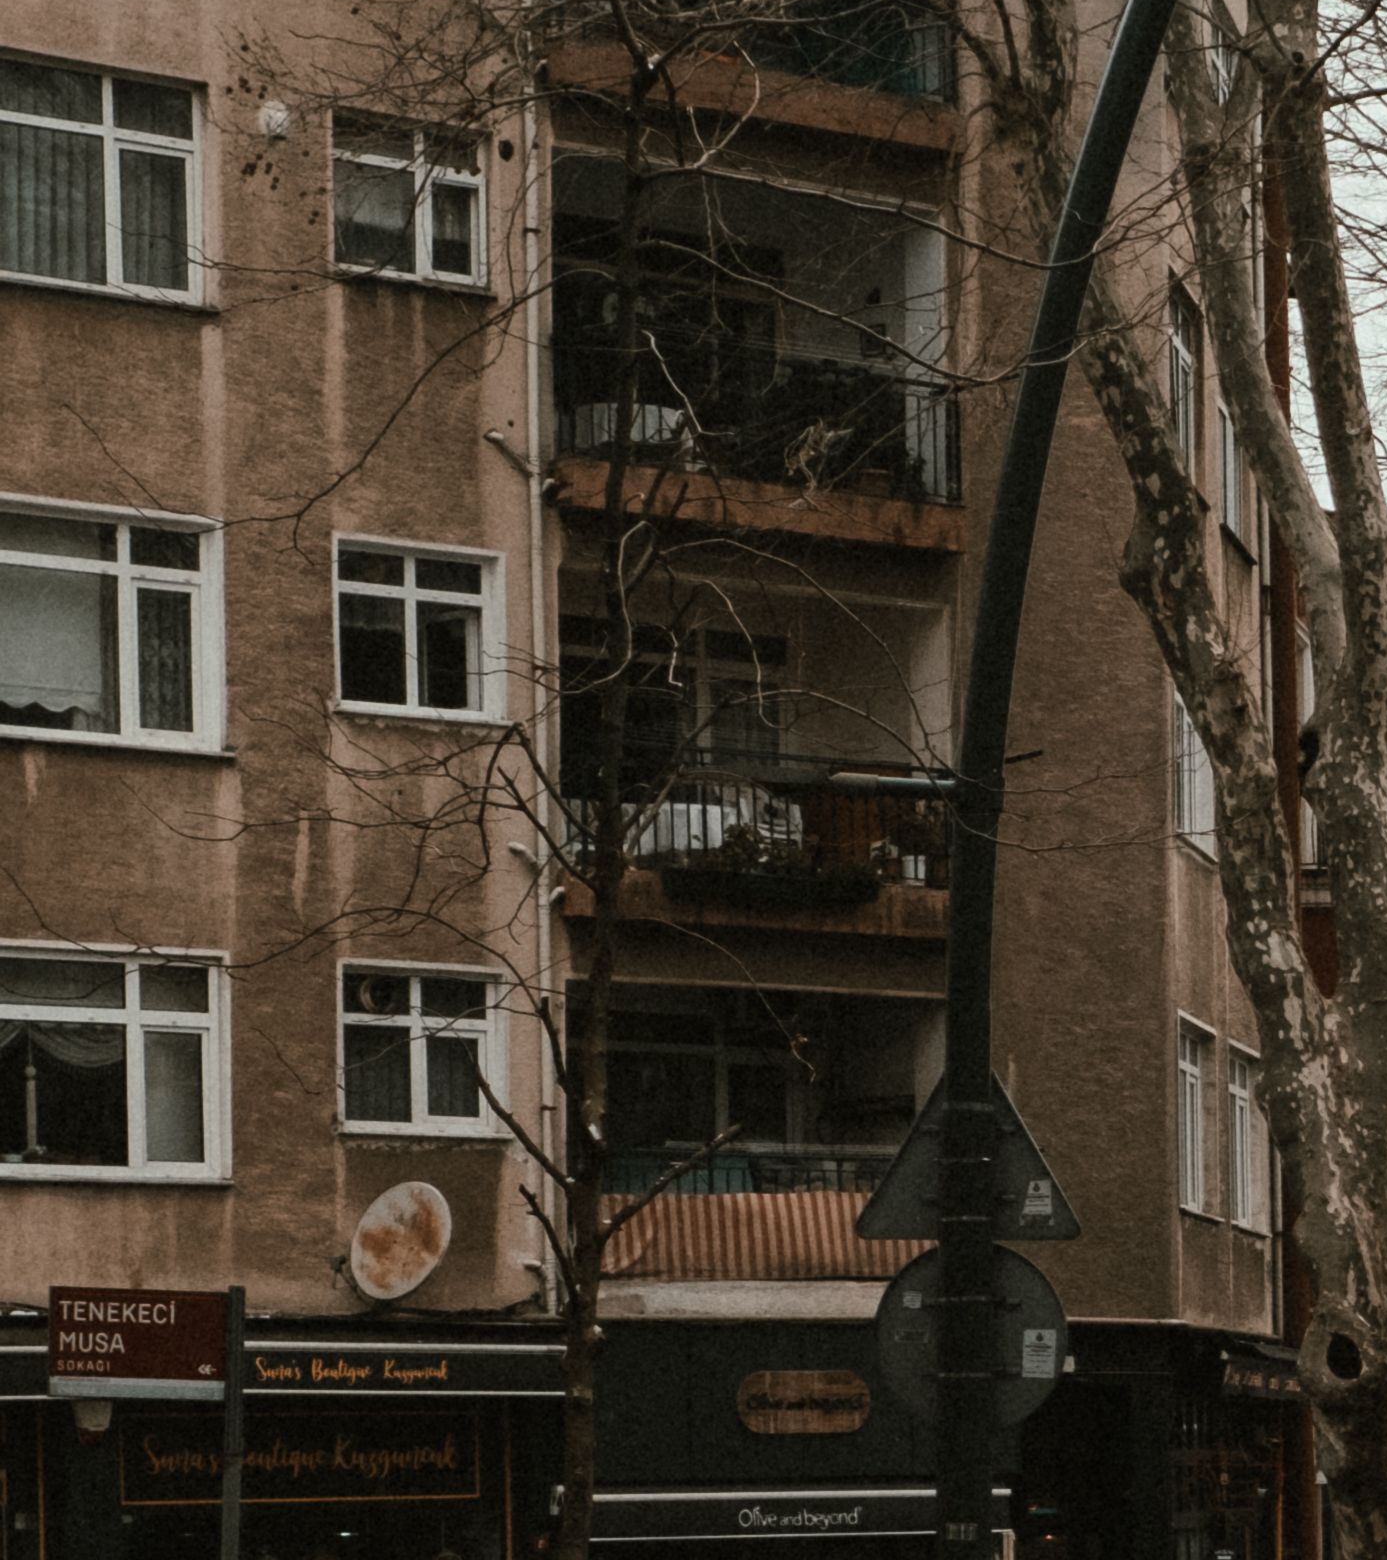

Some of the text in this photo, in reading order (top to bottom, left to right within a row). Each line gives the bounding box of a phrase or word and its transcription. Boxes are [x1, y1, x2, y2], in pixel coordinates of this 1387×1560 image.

[58, 1299, 176, 1326] TENEKECİ
[58, 1330, 126, 1354] MUSA
[738, 1505, 859, 1530] Olive and beyond
